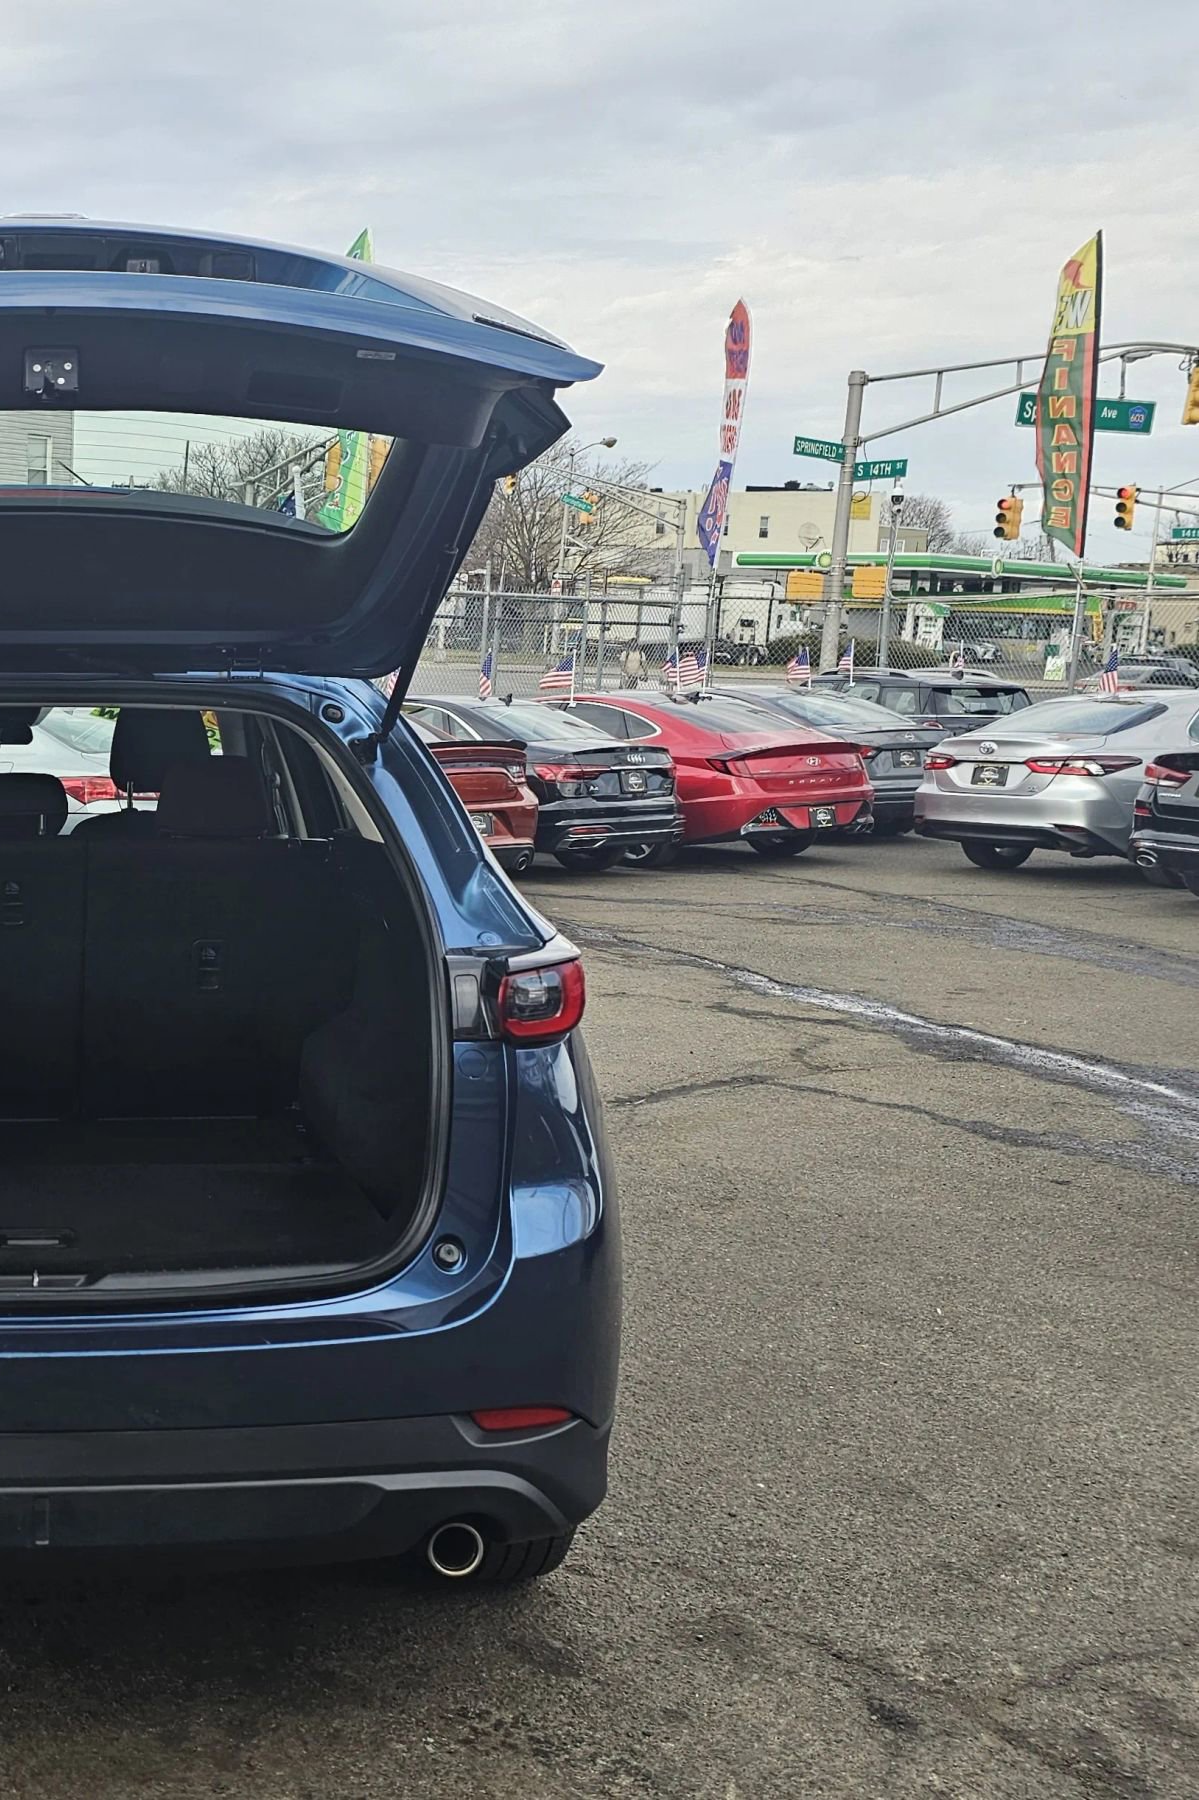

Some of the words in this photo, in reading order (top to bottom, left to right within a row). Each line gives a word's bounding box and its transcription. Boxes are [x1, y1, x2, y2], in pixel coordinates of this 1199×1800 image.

[1101, 406, 1118, 419] Ave
[796, 440, 837, 458] SPRINGFIELD
[857, 465, 864, 476] S
[869, 463, 892, 476] 14TH
